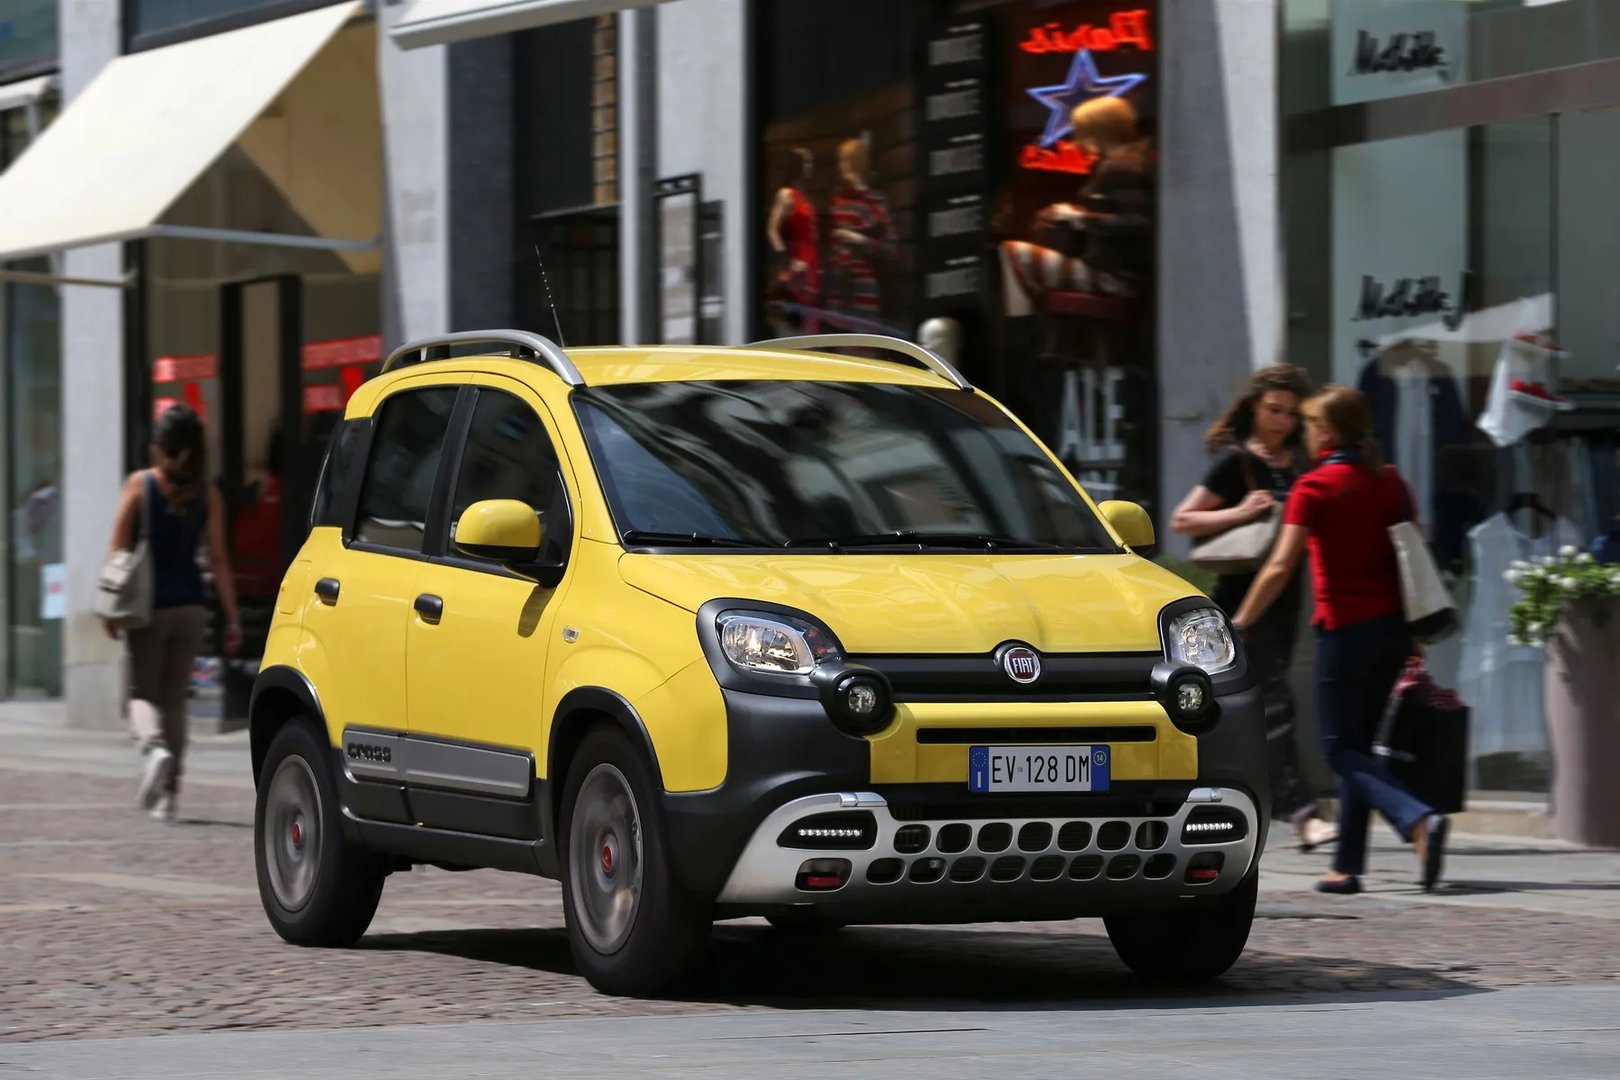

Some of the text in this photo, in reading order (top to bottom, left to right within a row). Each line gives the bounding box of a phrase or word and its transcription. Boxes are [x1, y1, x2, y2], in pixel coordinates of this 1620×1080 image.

[1012, 657, 1033, 673] FIAT
[992, 755, 1089, 783] EV 128 DM
